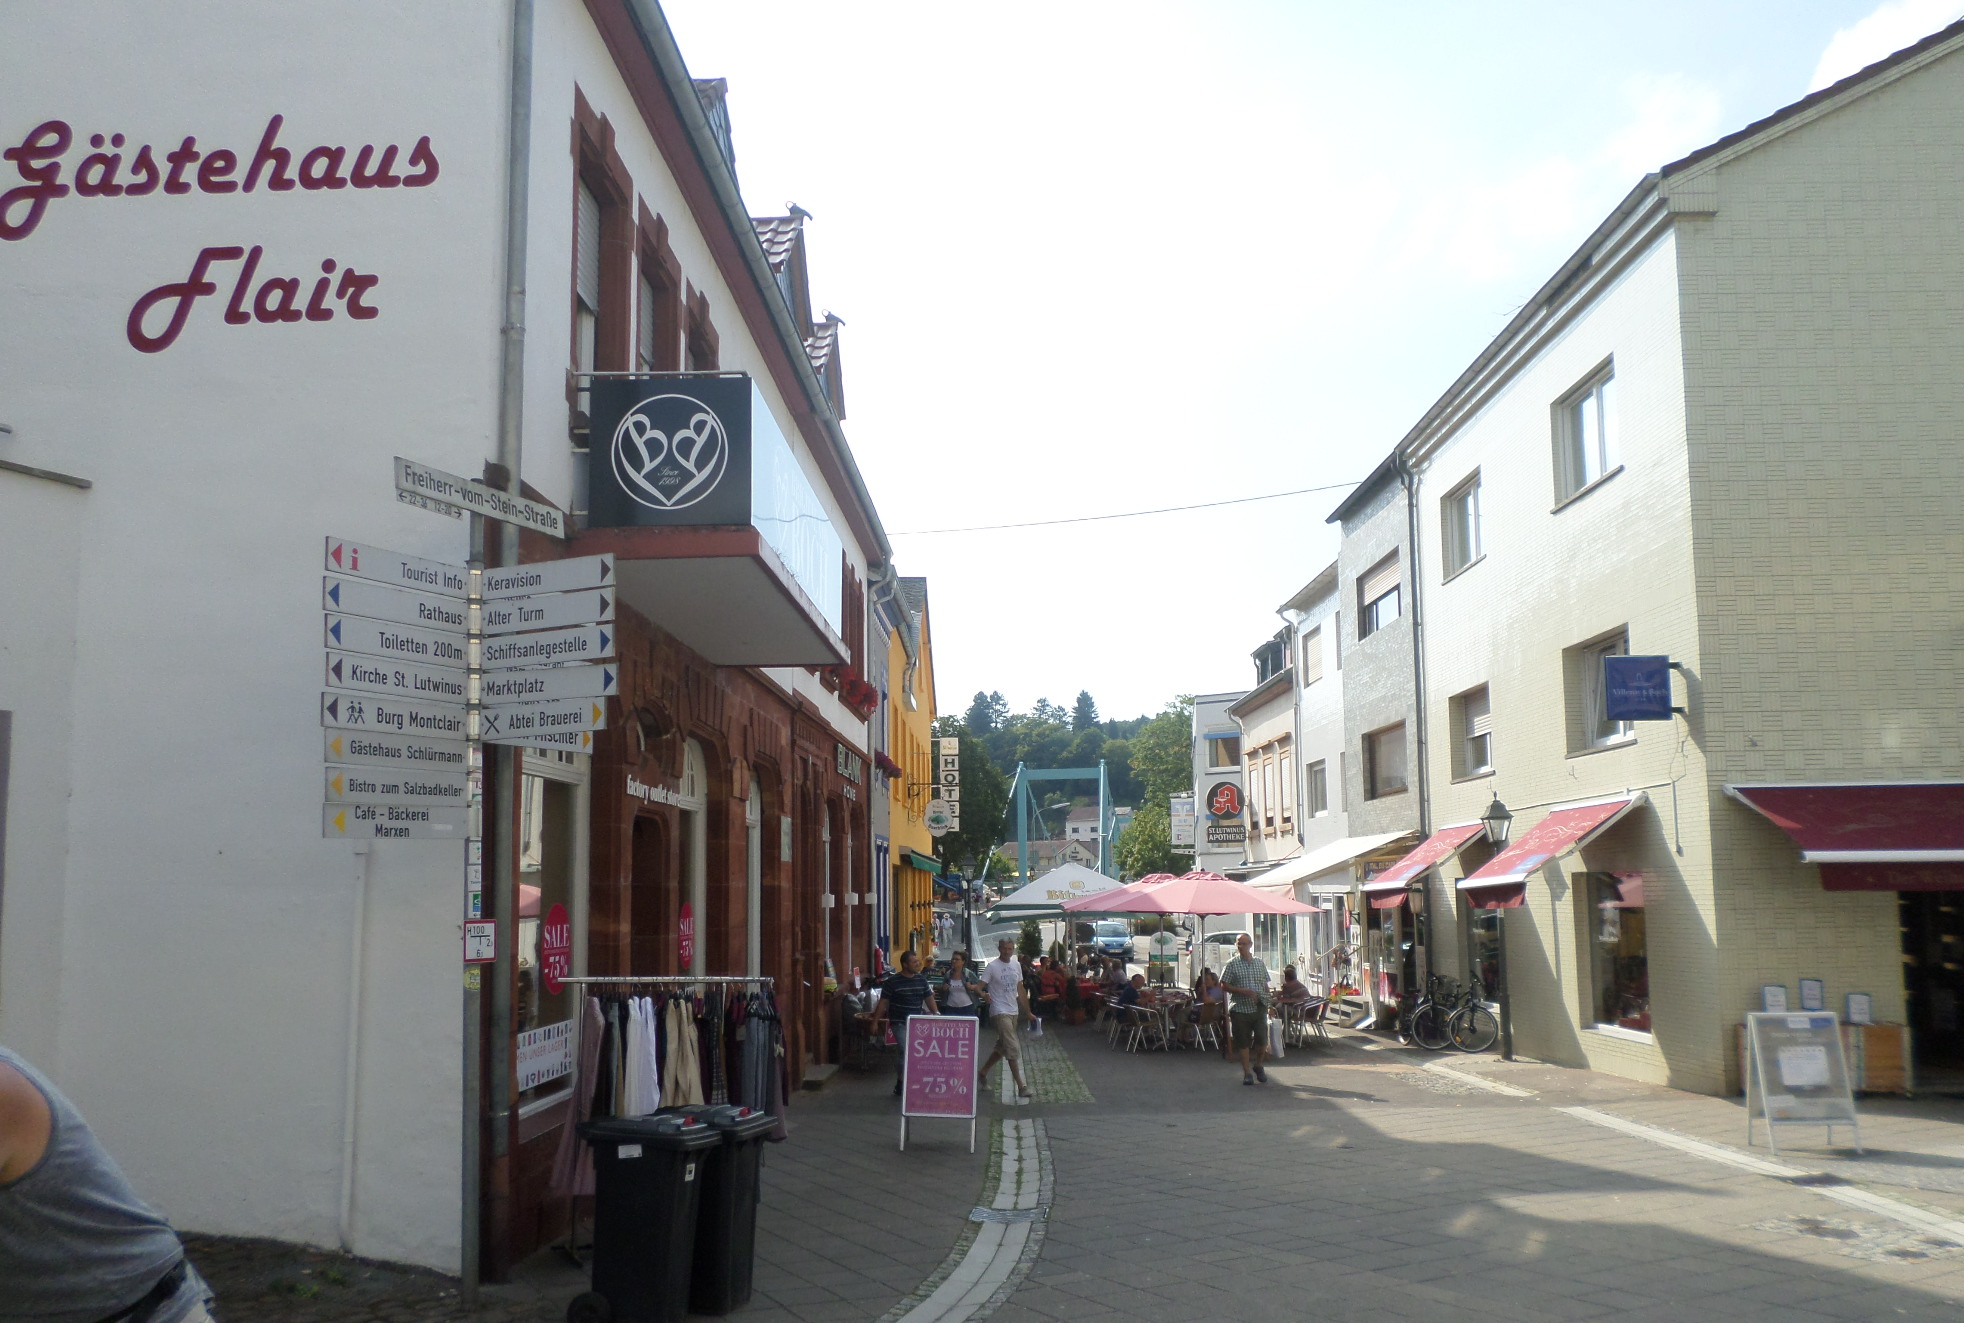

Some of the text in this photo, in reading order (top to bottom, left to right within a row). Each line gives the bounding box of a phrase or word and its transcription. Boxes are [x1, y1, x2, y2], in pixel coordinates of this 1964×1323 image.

[0, 113, 441, 242] Gästehaus
[126, 244, 380, 354] Flair
[403, 463, 558, 531] Freiherr-vom-Stein-Straße
[400, 562, 438, 586] Tourist
[443, 573, 463, 591] Info
[486, 573, 542, 592] Keravision
[418, 602, 463, 626] Rathaus
[487, 606, 544, 627] Alter Turm
[378, 631, 463, 661] Toiletten 200m
[486, 636, 588, 661] Schiffsanlegestelle
[351, 664, 463, 696] Kirche St. Lutwinus
[486, 677, 545, 698] Marktplatz
[376, 707, 462, 733] Burg Montclair
[508, 707, 582, 730] Abtei Brauerei
[350, 740, 463, 764] Gästehaus Schlürmann
[349, 778, 377, 794] Bistro
[380, 783, 399, 795] zum
[403, 781, 463, 798] Salzbadkeller
[627, 774, 649, 805] factory
[354, 804, 376, 821] Café
[388, 807, 429, 822] Bäckerei
[375, 822, 410, 838] Marxen
[544, 925, 570, 948] SALE
[680, 918, 694, 936] SALE
[932, 1027, 969, 1038] BOCH
[914, 1040, 969, 1058] SALE
